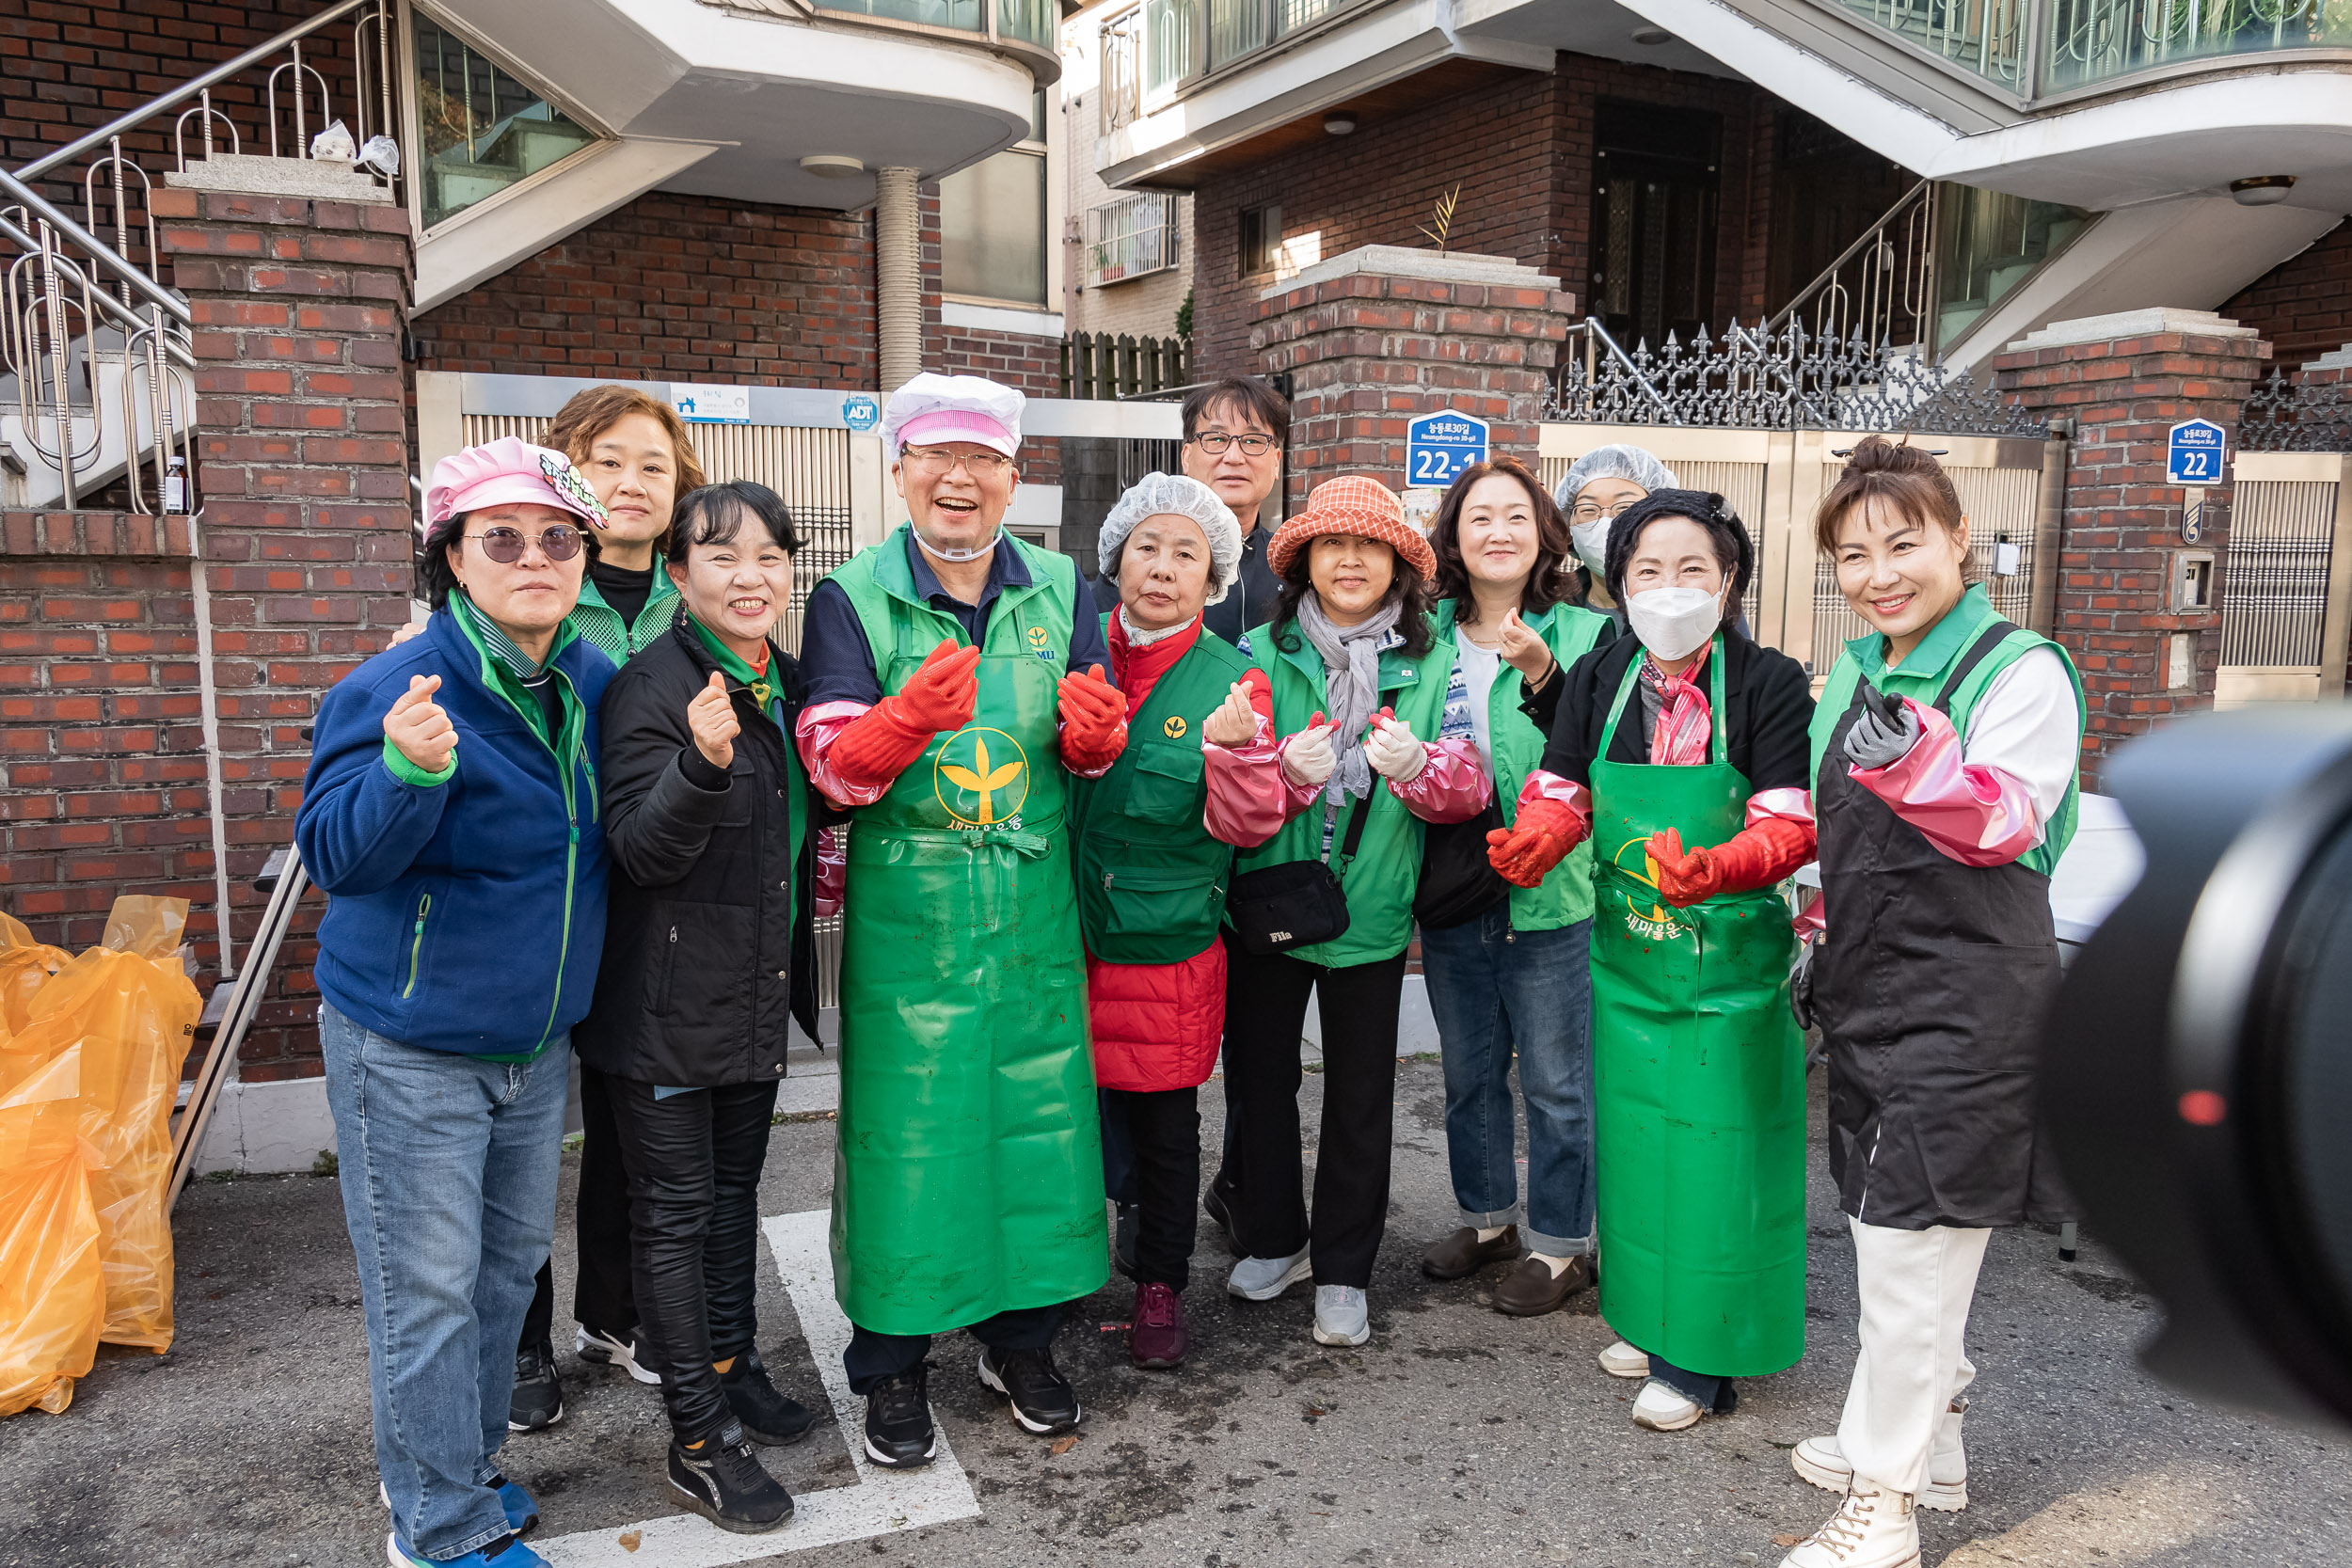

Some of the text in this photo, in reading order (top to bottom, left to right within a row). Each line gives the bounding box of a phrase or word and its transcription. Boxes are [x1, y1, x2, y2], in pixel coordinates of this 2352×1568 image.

[848, 405, 873, 420] ADT
[1429, 422, 1470, 435] 능동로30길
[1422, 434, 1476, 443] Neungdong-ro 30-gil
[2183, 452, 2207, 476] 22
[540, 455, 571, 489] 광진구
[1624, 912, 1692, 941] 새마을운
[1269, 931, 1292, 942] Fila
